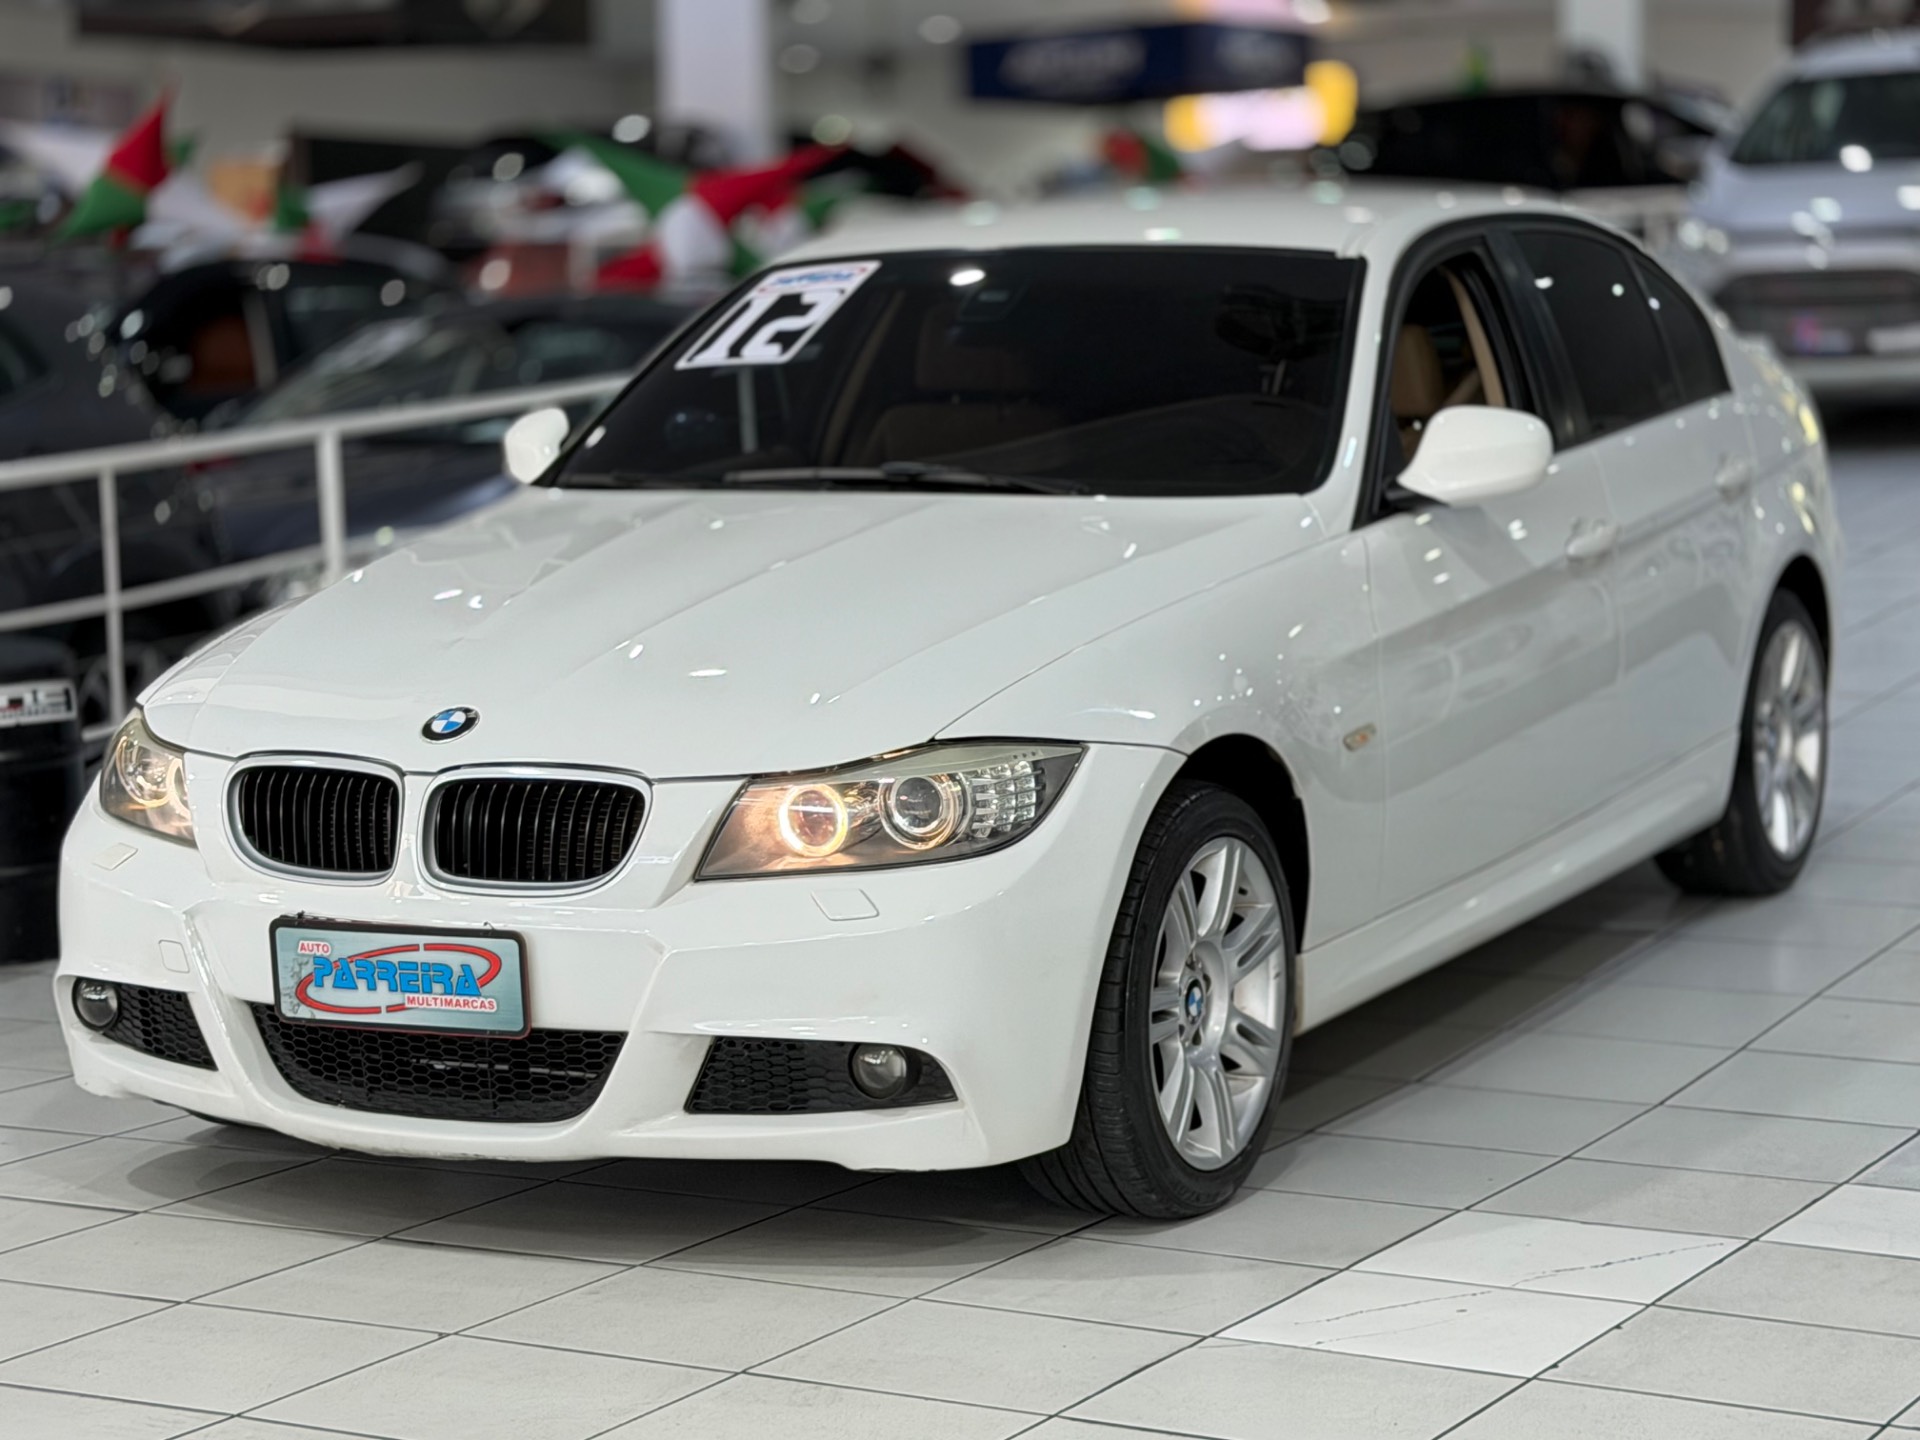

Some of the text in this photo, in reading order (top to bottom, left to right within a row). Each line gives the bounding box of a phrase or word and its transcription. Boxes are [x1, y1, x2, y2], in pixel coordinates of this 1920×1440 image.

[688, 290, 845, 359] 12
[299, 941, 330, 954] AUTO
[312, 956, 481, 996] PARREIRA
[406, 995, 496, 1011] MULTIMARCAS
